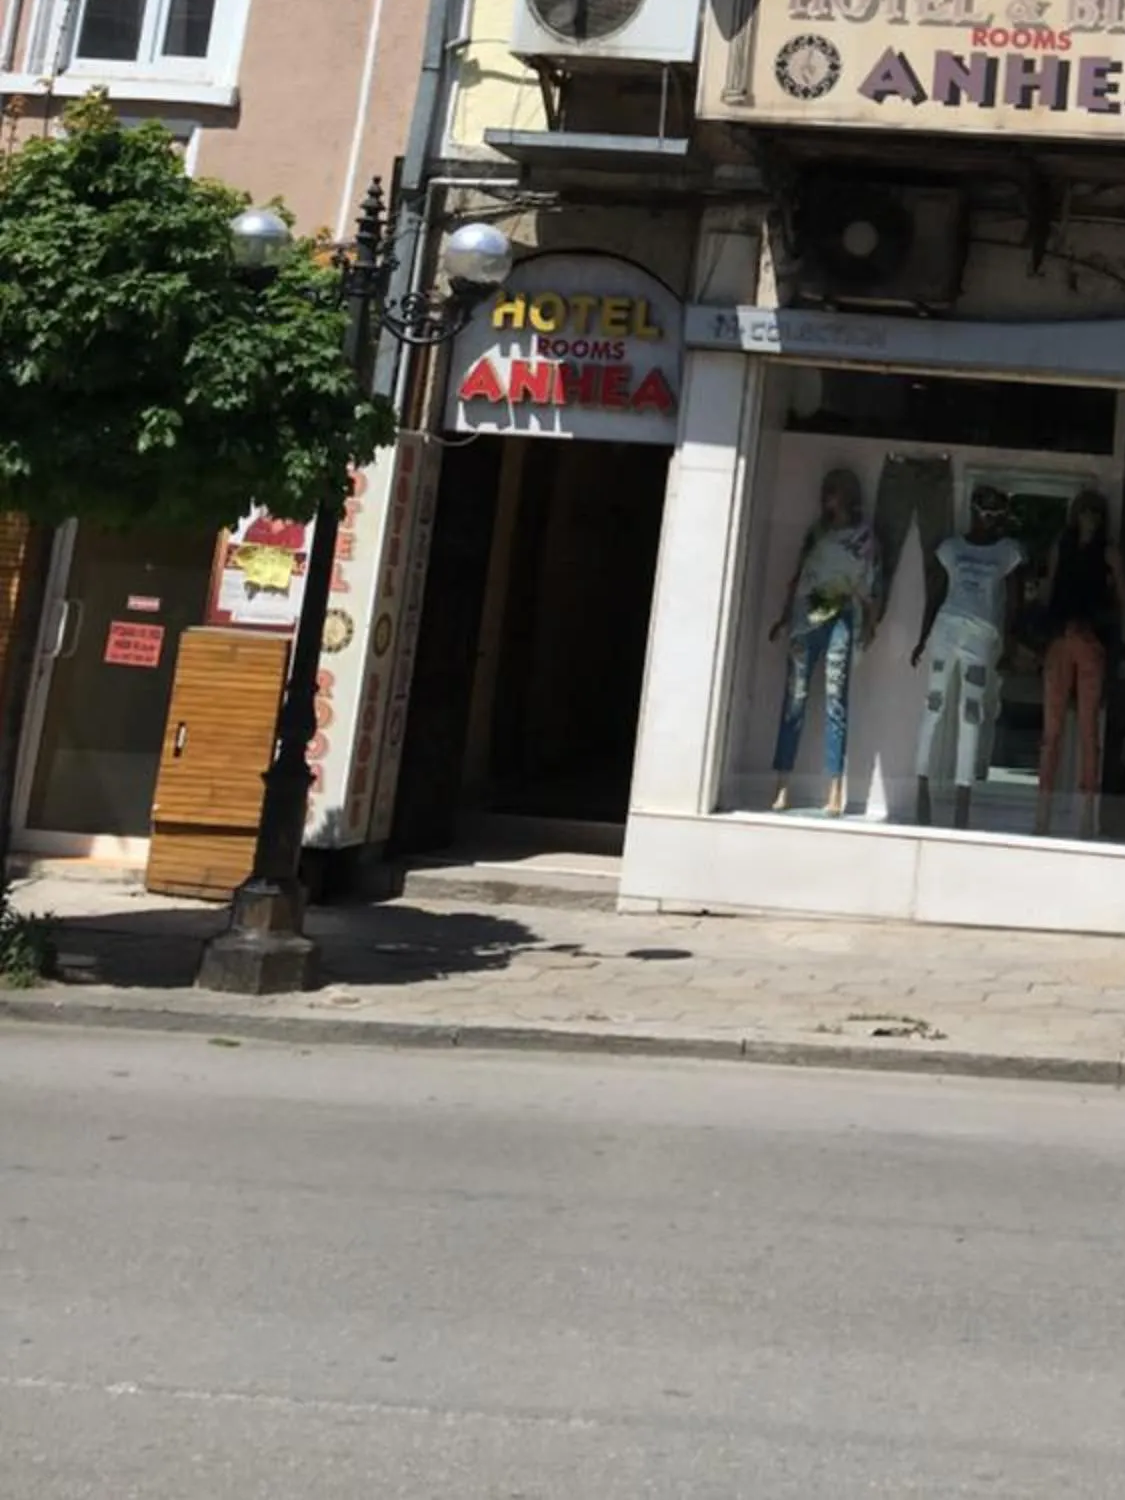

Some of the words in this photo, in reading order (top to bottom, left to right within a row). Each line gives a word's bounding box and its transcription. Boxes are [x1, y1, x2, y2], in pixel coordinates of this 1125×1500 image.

[971, 26, 1073, 51] ROOMS
[491, 291, 666, 338] HOTEL
[535, 337, 626, 360] ROOMS
[459, 357, 677, 415] ANHEA
